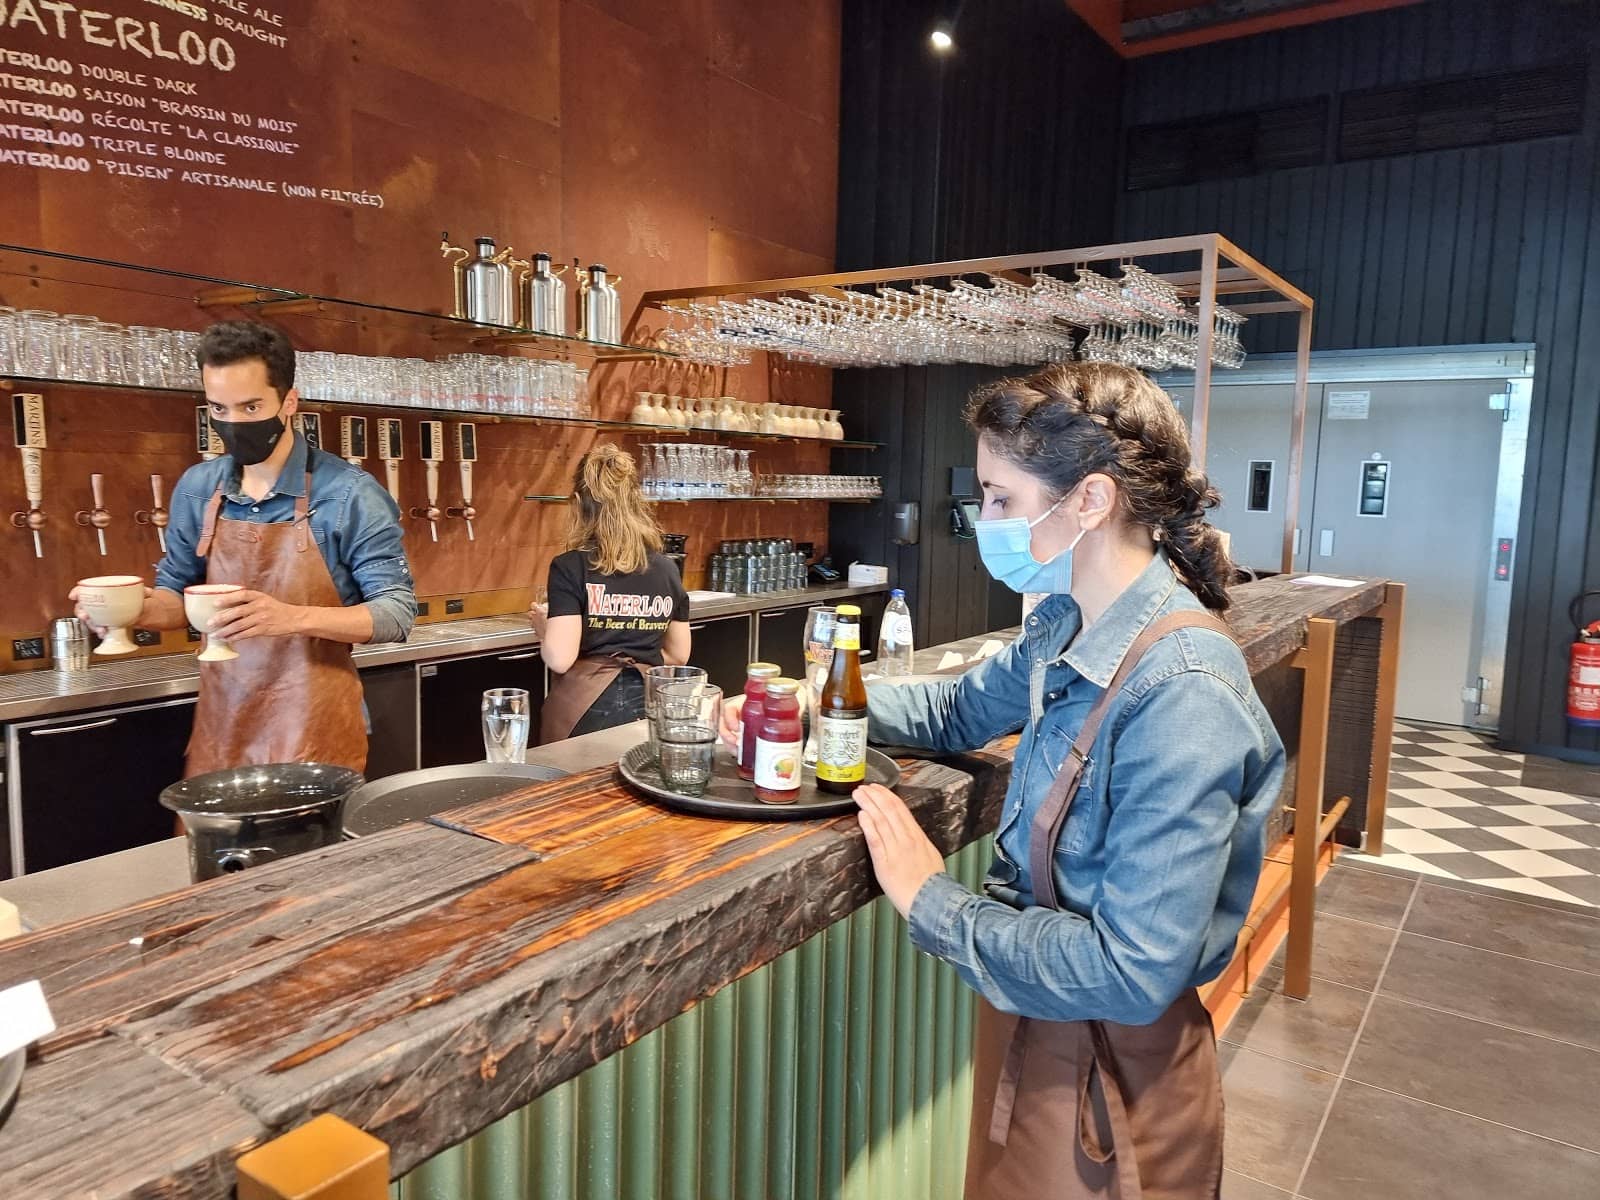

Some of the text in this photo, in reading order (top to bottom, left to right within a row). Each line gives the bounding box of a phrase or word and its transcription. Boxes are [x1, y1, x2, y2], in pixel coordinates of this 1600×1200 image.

[210, 0, 283, 28] ALE ALE
[213, 13, 288, 48] DRAUGHT
[0, 0, 236, 72] ATERLOO
[78, 63, 148, 87] DOUBLE
[153, 76, 198, 96] DARK
[82, 86, 146, 109] SAISON
[151, 97, 227, 122] "BRASSIN
[231, 112, 252, 127] DU
[257, 117, 298, 133] MOIS"
[91, 109, 173, 136] RÉCOLTE
[178, 123, 209, 141] "LA
[212, 131, 300, 154] CLASSIQUE"
[89, 135, 158, 156] TRIPLE
[163, 146, 227, 166] BLONDE
[96, 159, 174, 180] "PILSEN"
[181, 171, 277, 193] ARTISANALE
[282, 181, 317, 198] (NON
[320, 188, 385, 209] FILTRÉE)
[588, 617, 671, 633] The Beer of Bravery
